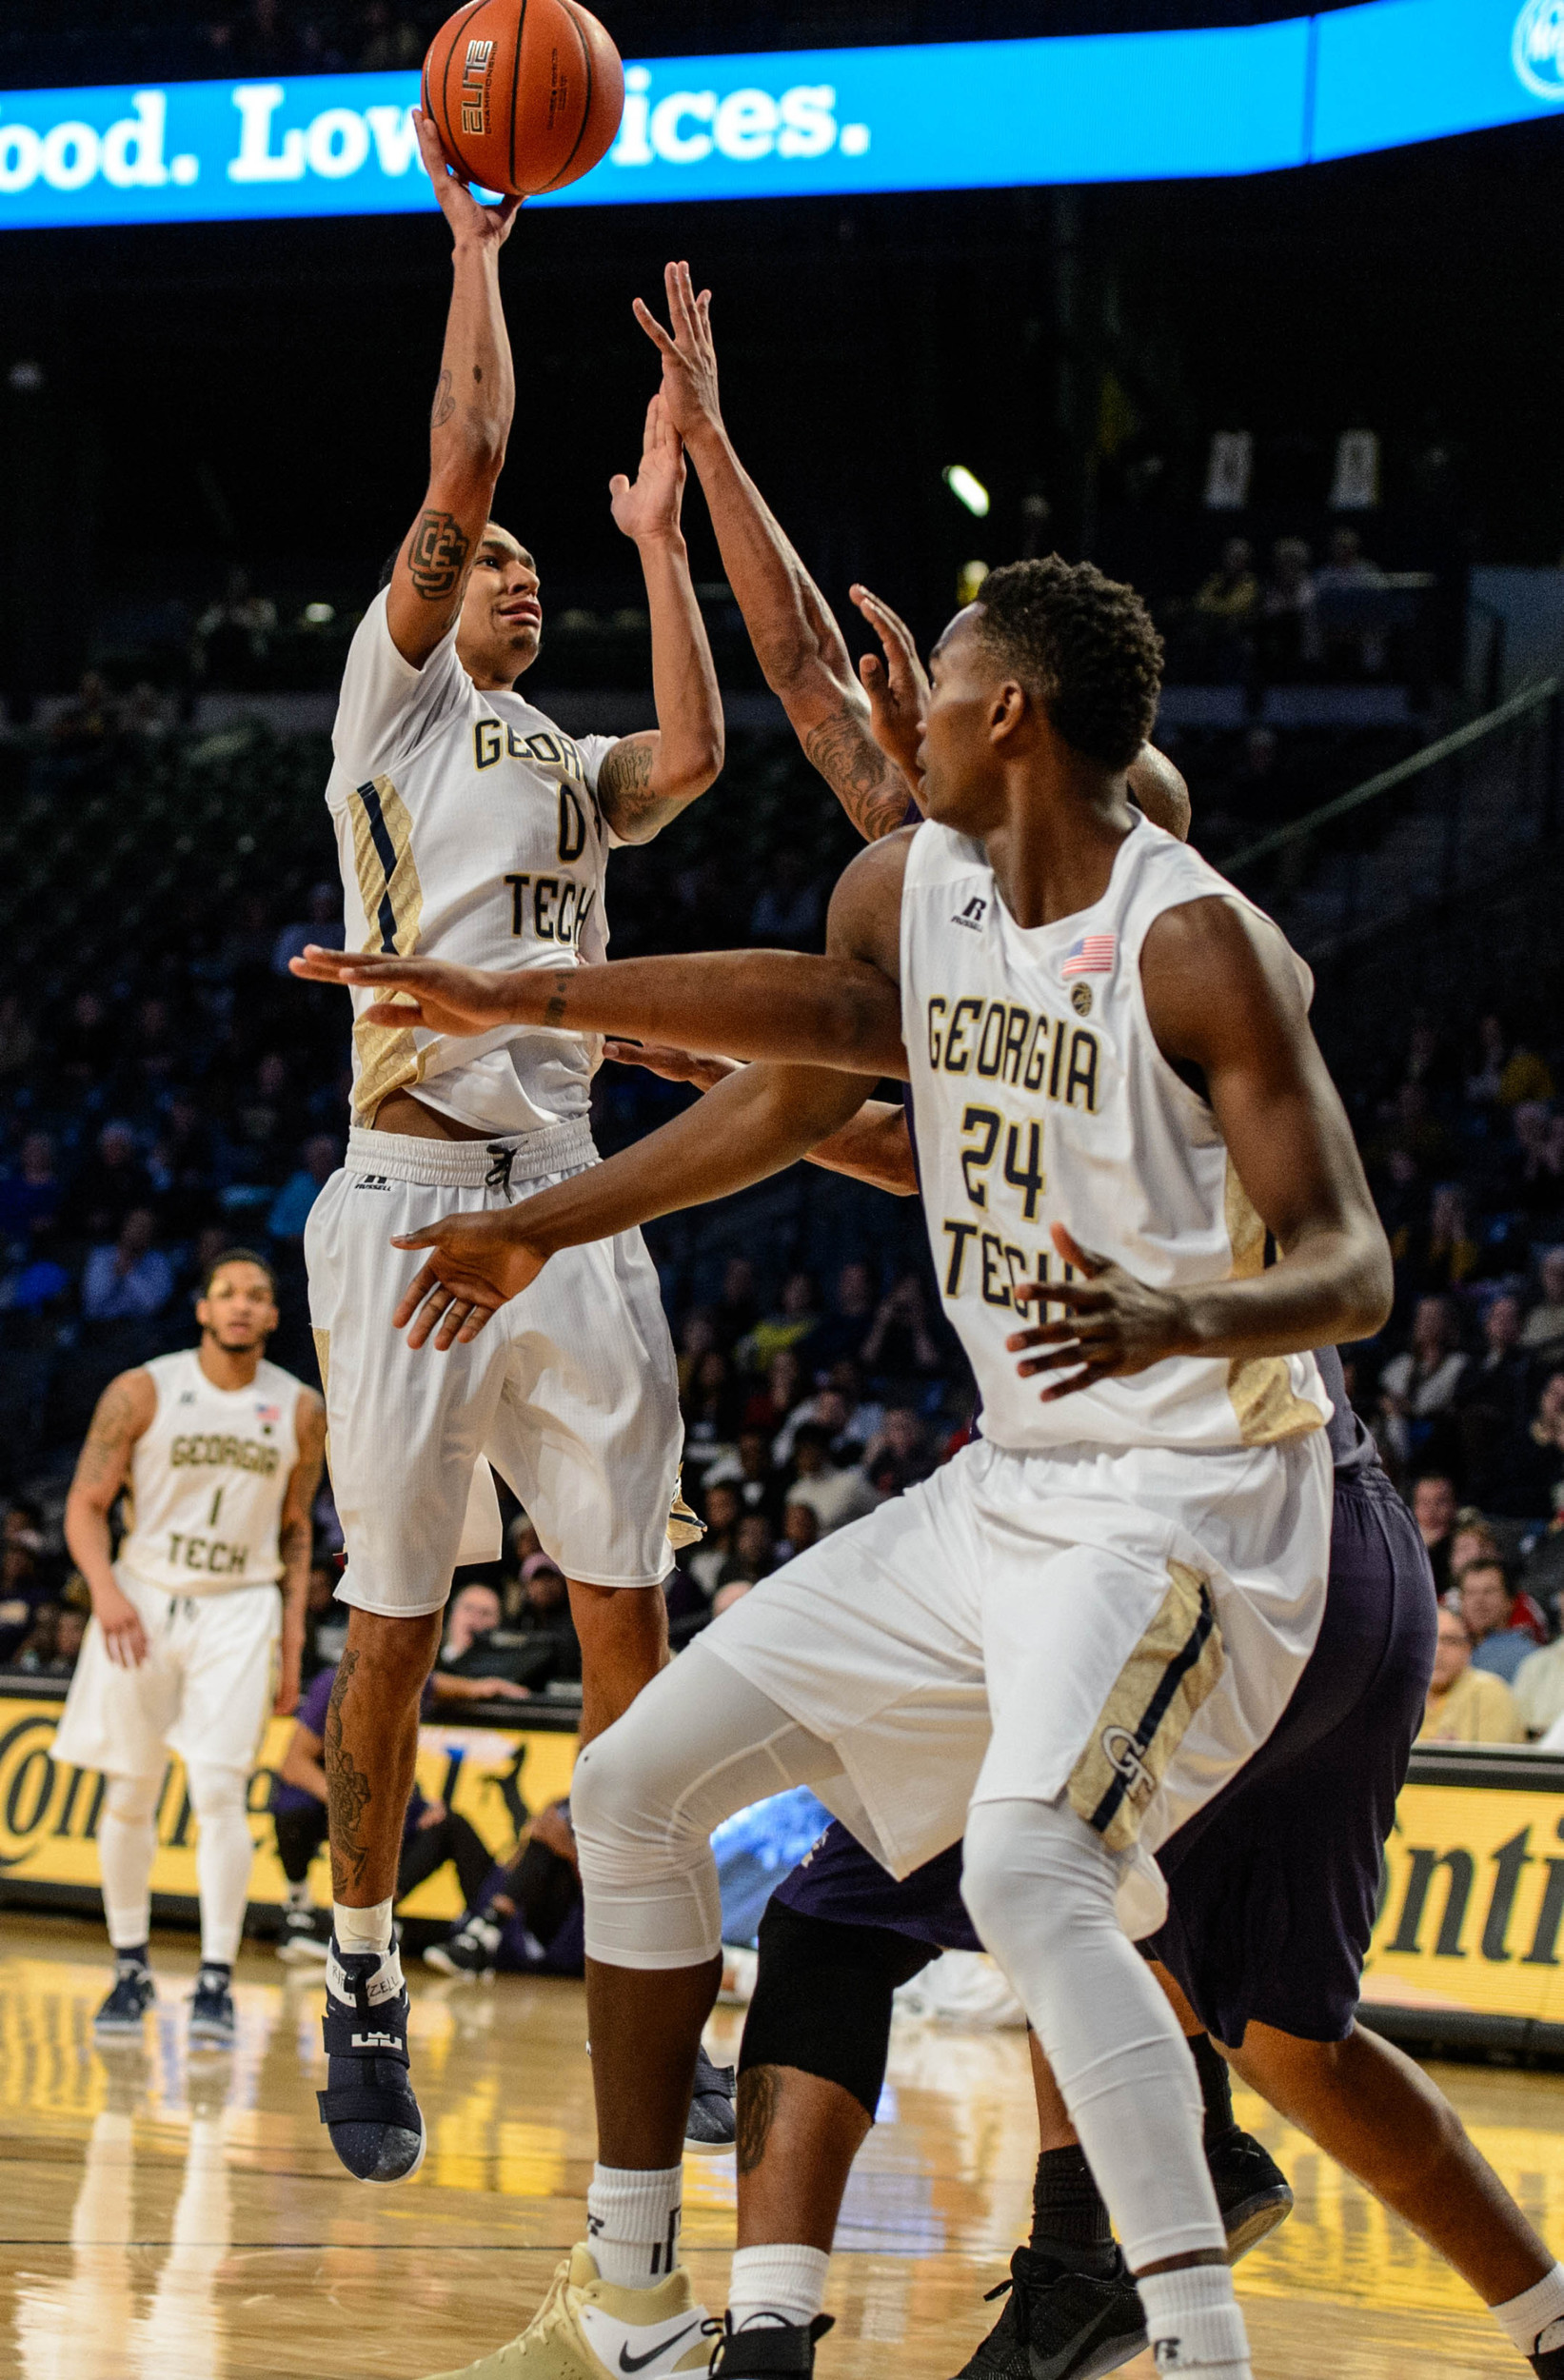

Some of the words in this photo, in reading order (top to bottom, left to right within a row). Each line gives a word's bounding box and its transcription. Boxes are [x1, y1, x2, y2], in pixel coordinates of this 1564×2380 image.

[462, 40, 494, 135] ELITE
[504, 873, 597, 946] TECH
[928, 993, 1101, 1114] GEORGIA
[960, 1102, 1044, 1224] 24
[169, 1534, 247, 1573] TECH
